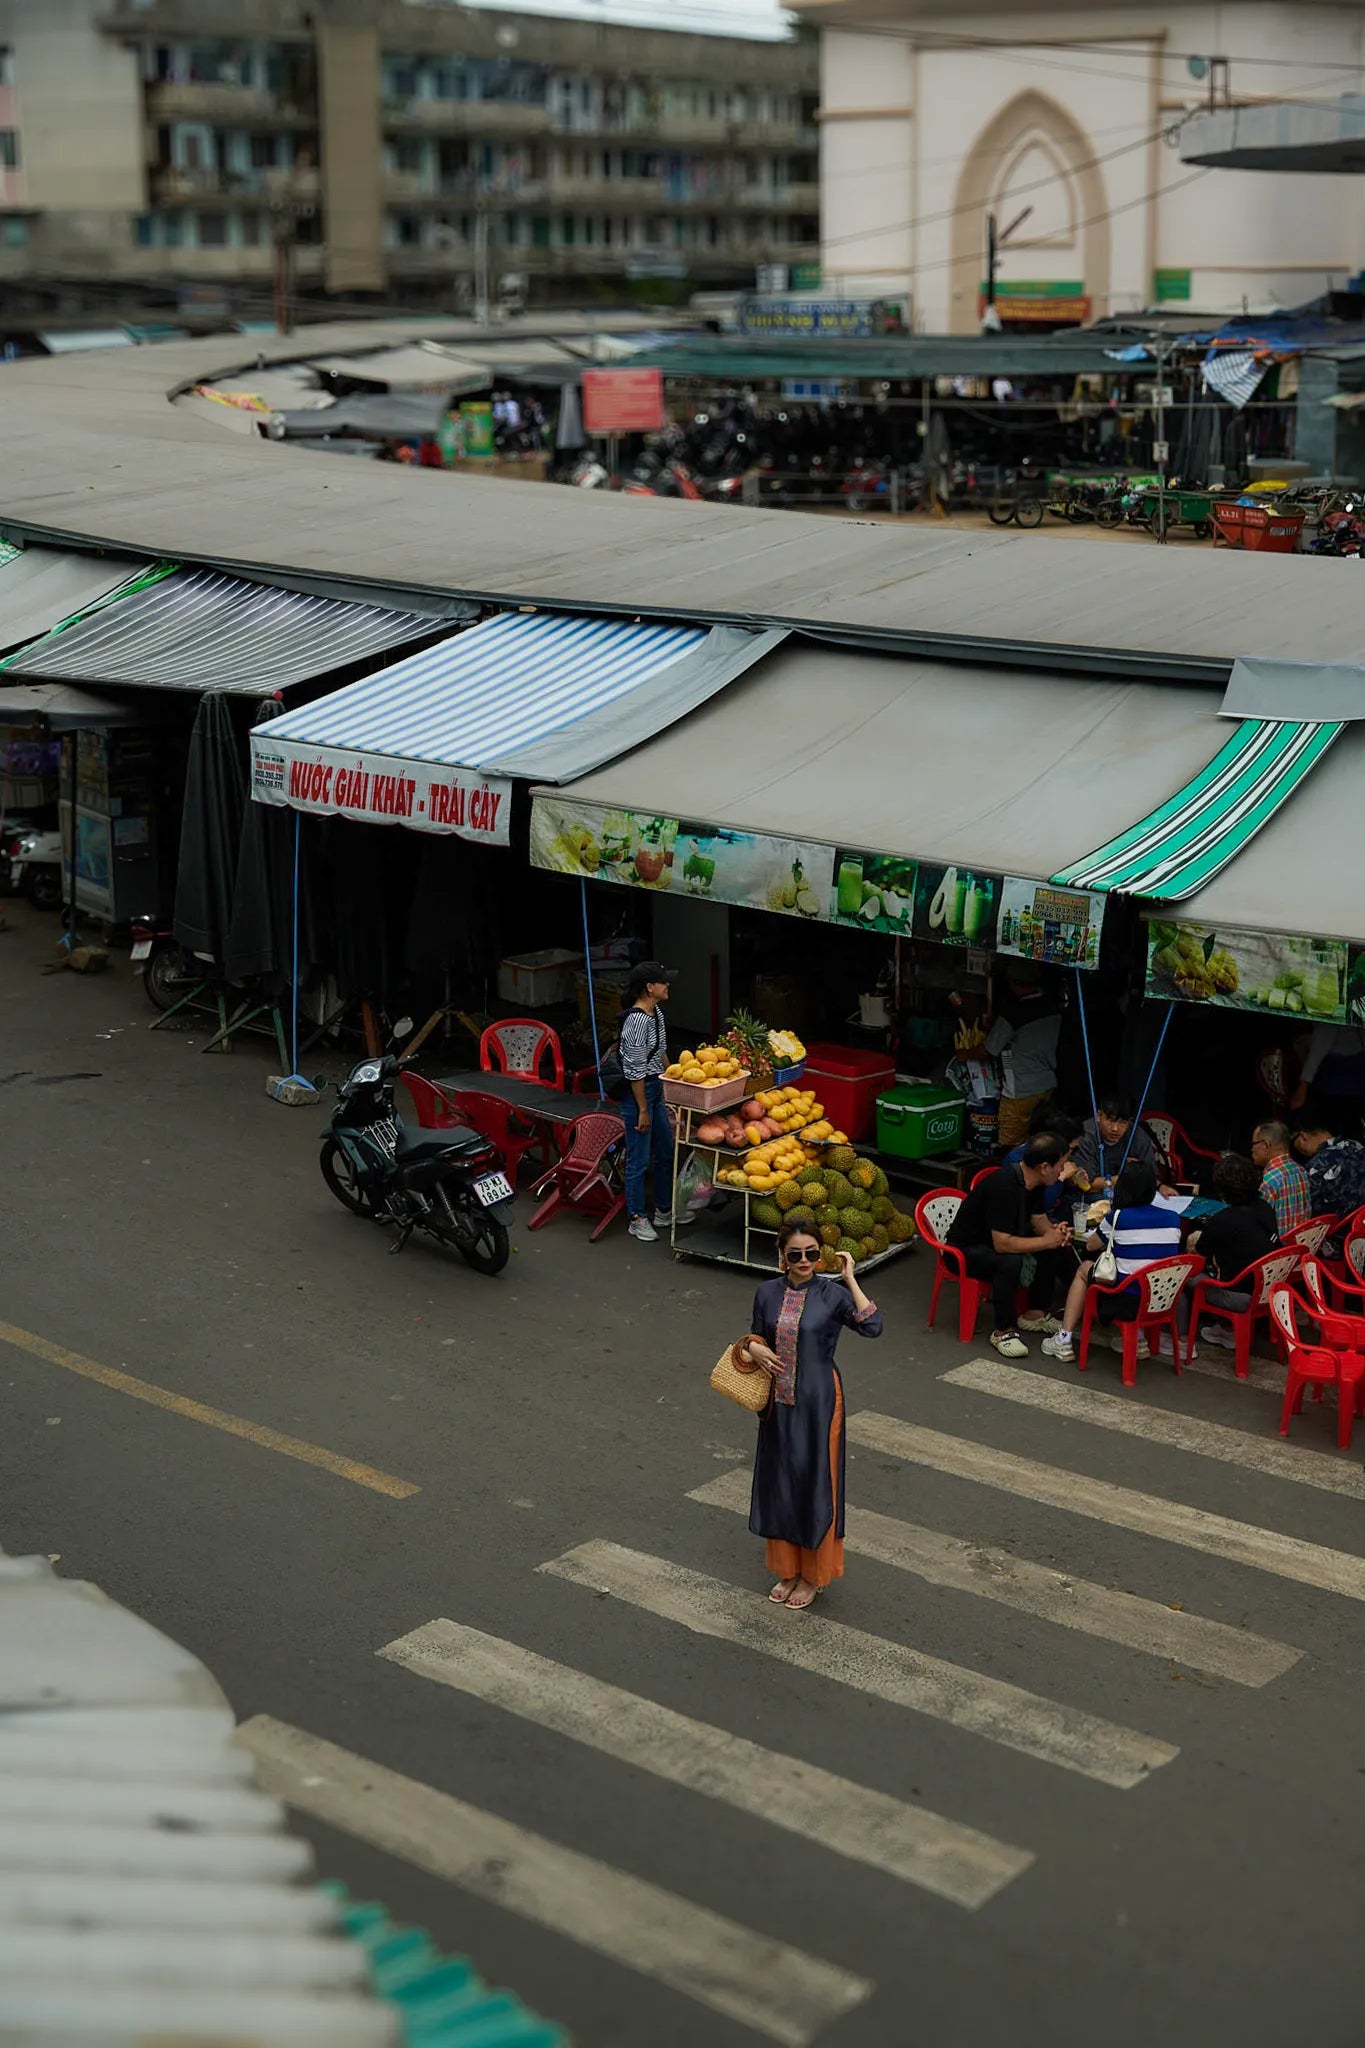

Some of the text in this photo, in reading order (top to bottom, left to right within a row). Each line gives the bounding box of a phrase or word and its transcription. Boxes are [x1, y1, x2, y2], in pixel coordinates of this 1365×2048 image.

[289, 755, 334, 804] NƯỚC
[333, 760, 370, 810] GIẢI
[371, 769, 416, 817] KHÁT
[429, 778, 466, 826] TRÁI
[468, 783, 502, 832] CÂY
